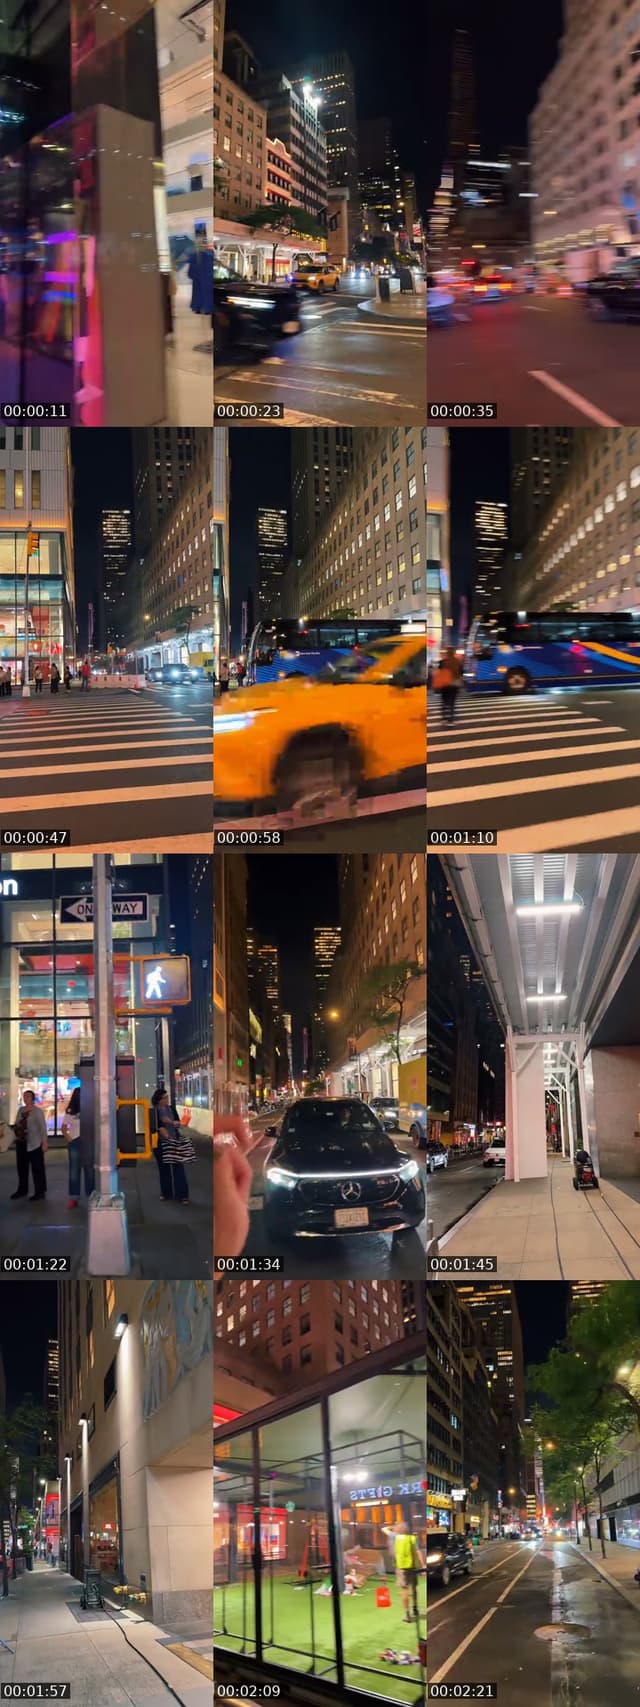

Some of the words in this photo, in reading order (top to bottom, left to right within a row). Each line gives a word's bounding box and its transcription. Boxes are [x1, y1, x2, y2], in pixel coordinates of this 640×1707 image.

[0, 878, 18, 896] n
[77, 902, 95, 915] ON
[111, 902, 139, 915] WAY
